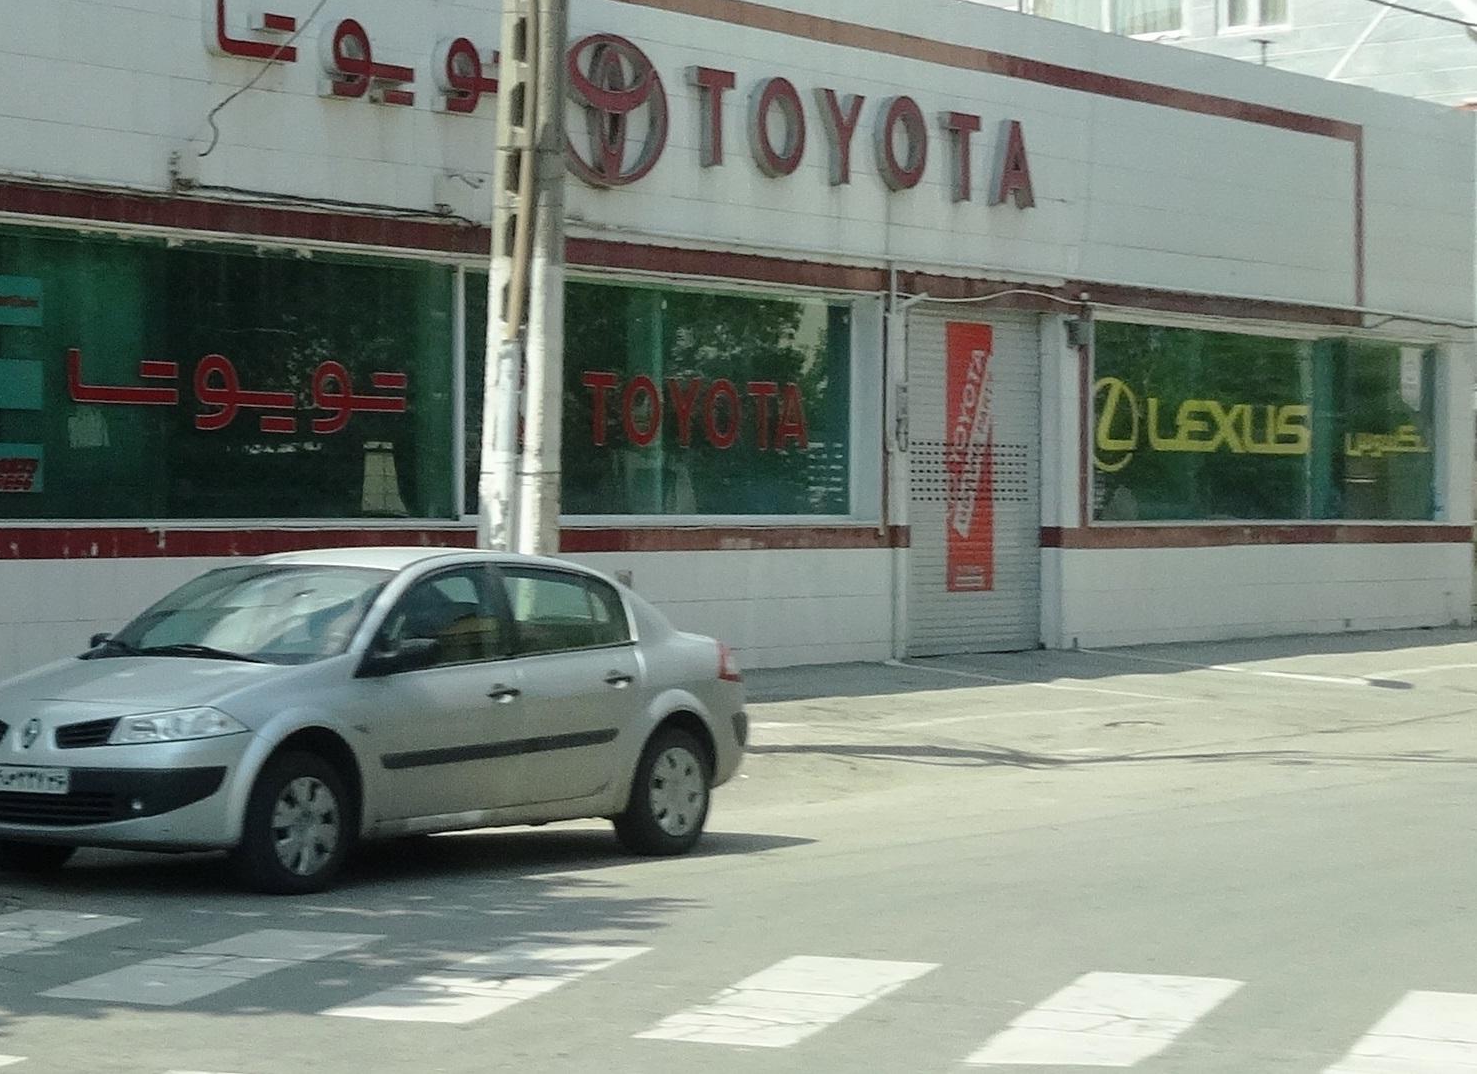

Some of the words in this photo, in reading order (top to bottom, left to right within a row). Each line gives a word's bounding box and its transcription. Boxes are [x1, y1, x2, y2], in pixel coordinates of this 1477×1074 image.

[686, 65, 1035, 209] TOYOTA
[68, 348, 407, 434] تویوتا
[582, 371, 809, 452] TOYOTA
[1147, 397, 1312, 454] LEXUS
